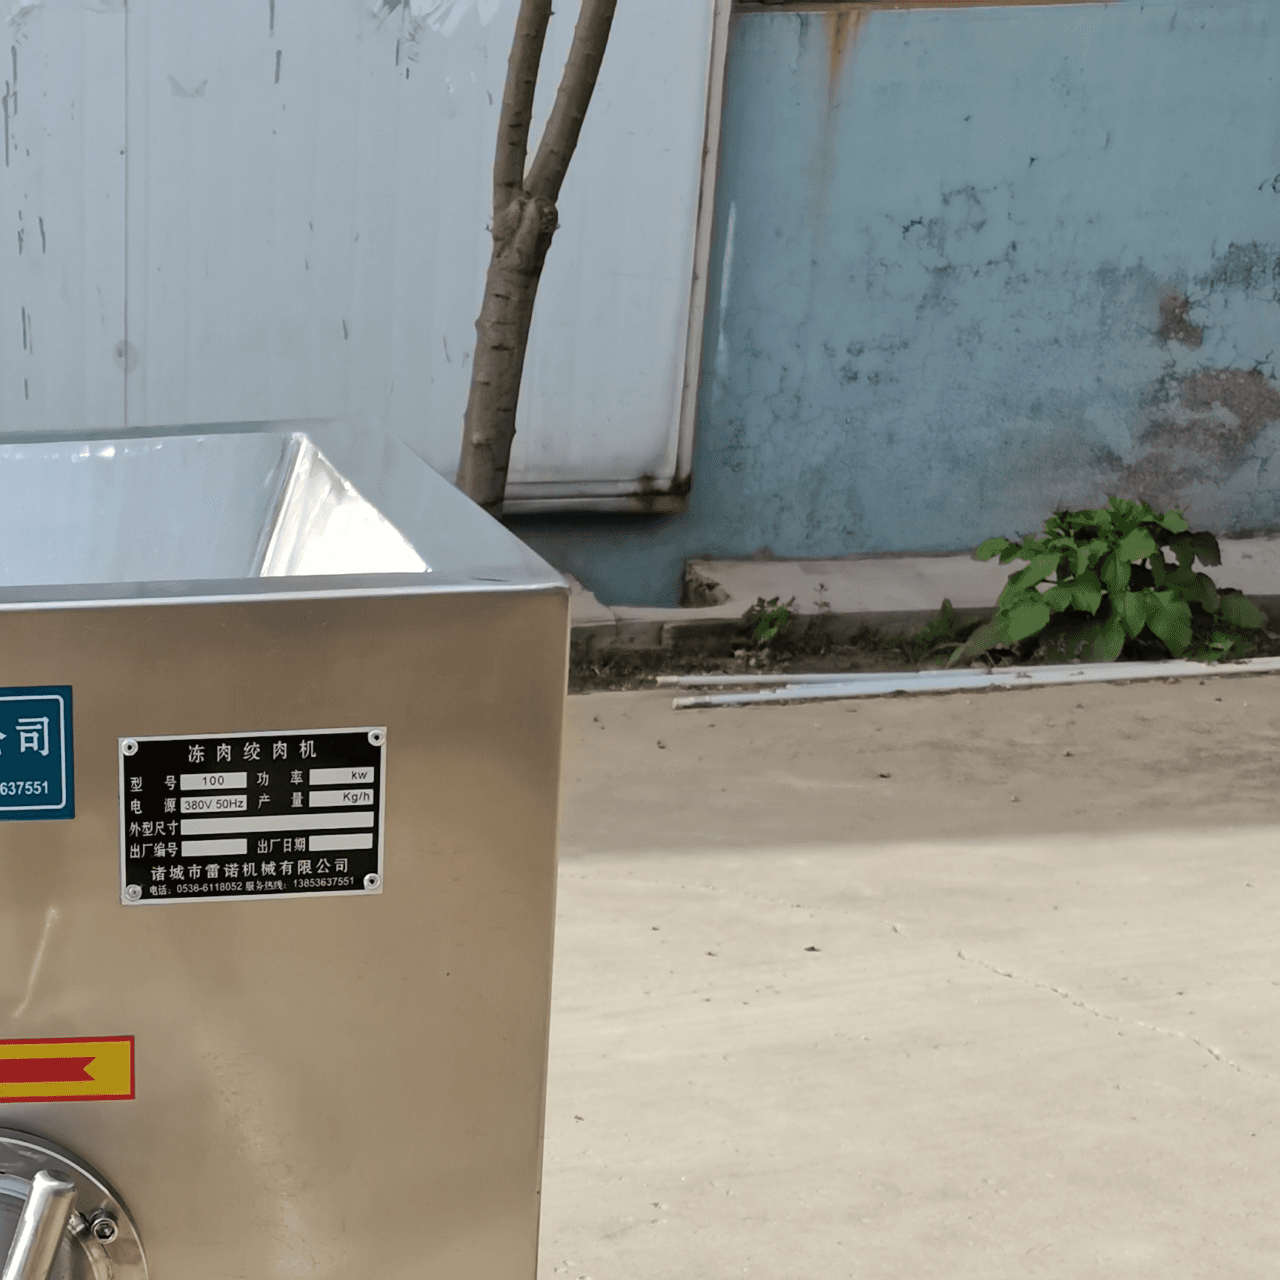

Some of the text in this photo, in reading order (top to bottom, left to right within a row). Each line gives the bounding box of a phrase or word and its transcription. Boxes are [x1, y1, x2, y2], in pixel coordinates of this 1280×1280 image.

[188, 739, 317, 763] 冻肉绞肉机
[202, 775, 225, 786] 100
[184, 800, 212, 810] 380V
[215, 799, 244, 809] 50Hz
[343, 792, 370, 803] Kg/h
[129, 820, 179, 837] 外型尺寸
[129, 842, 178, 858] 出厂编号
[257, 837, 306, 853] 出厂日期
[150, 858, 349, 881] 诸城市雷诺机械有限公司
